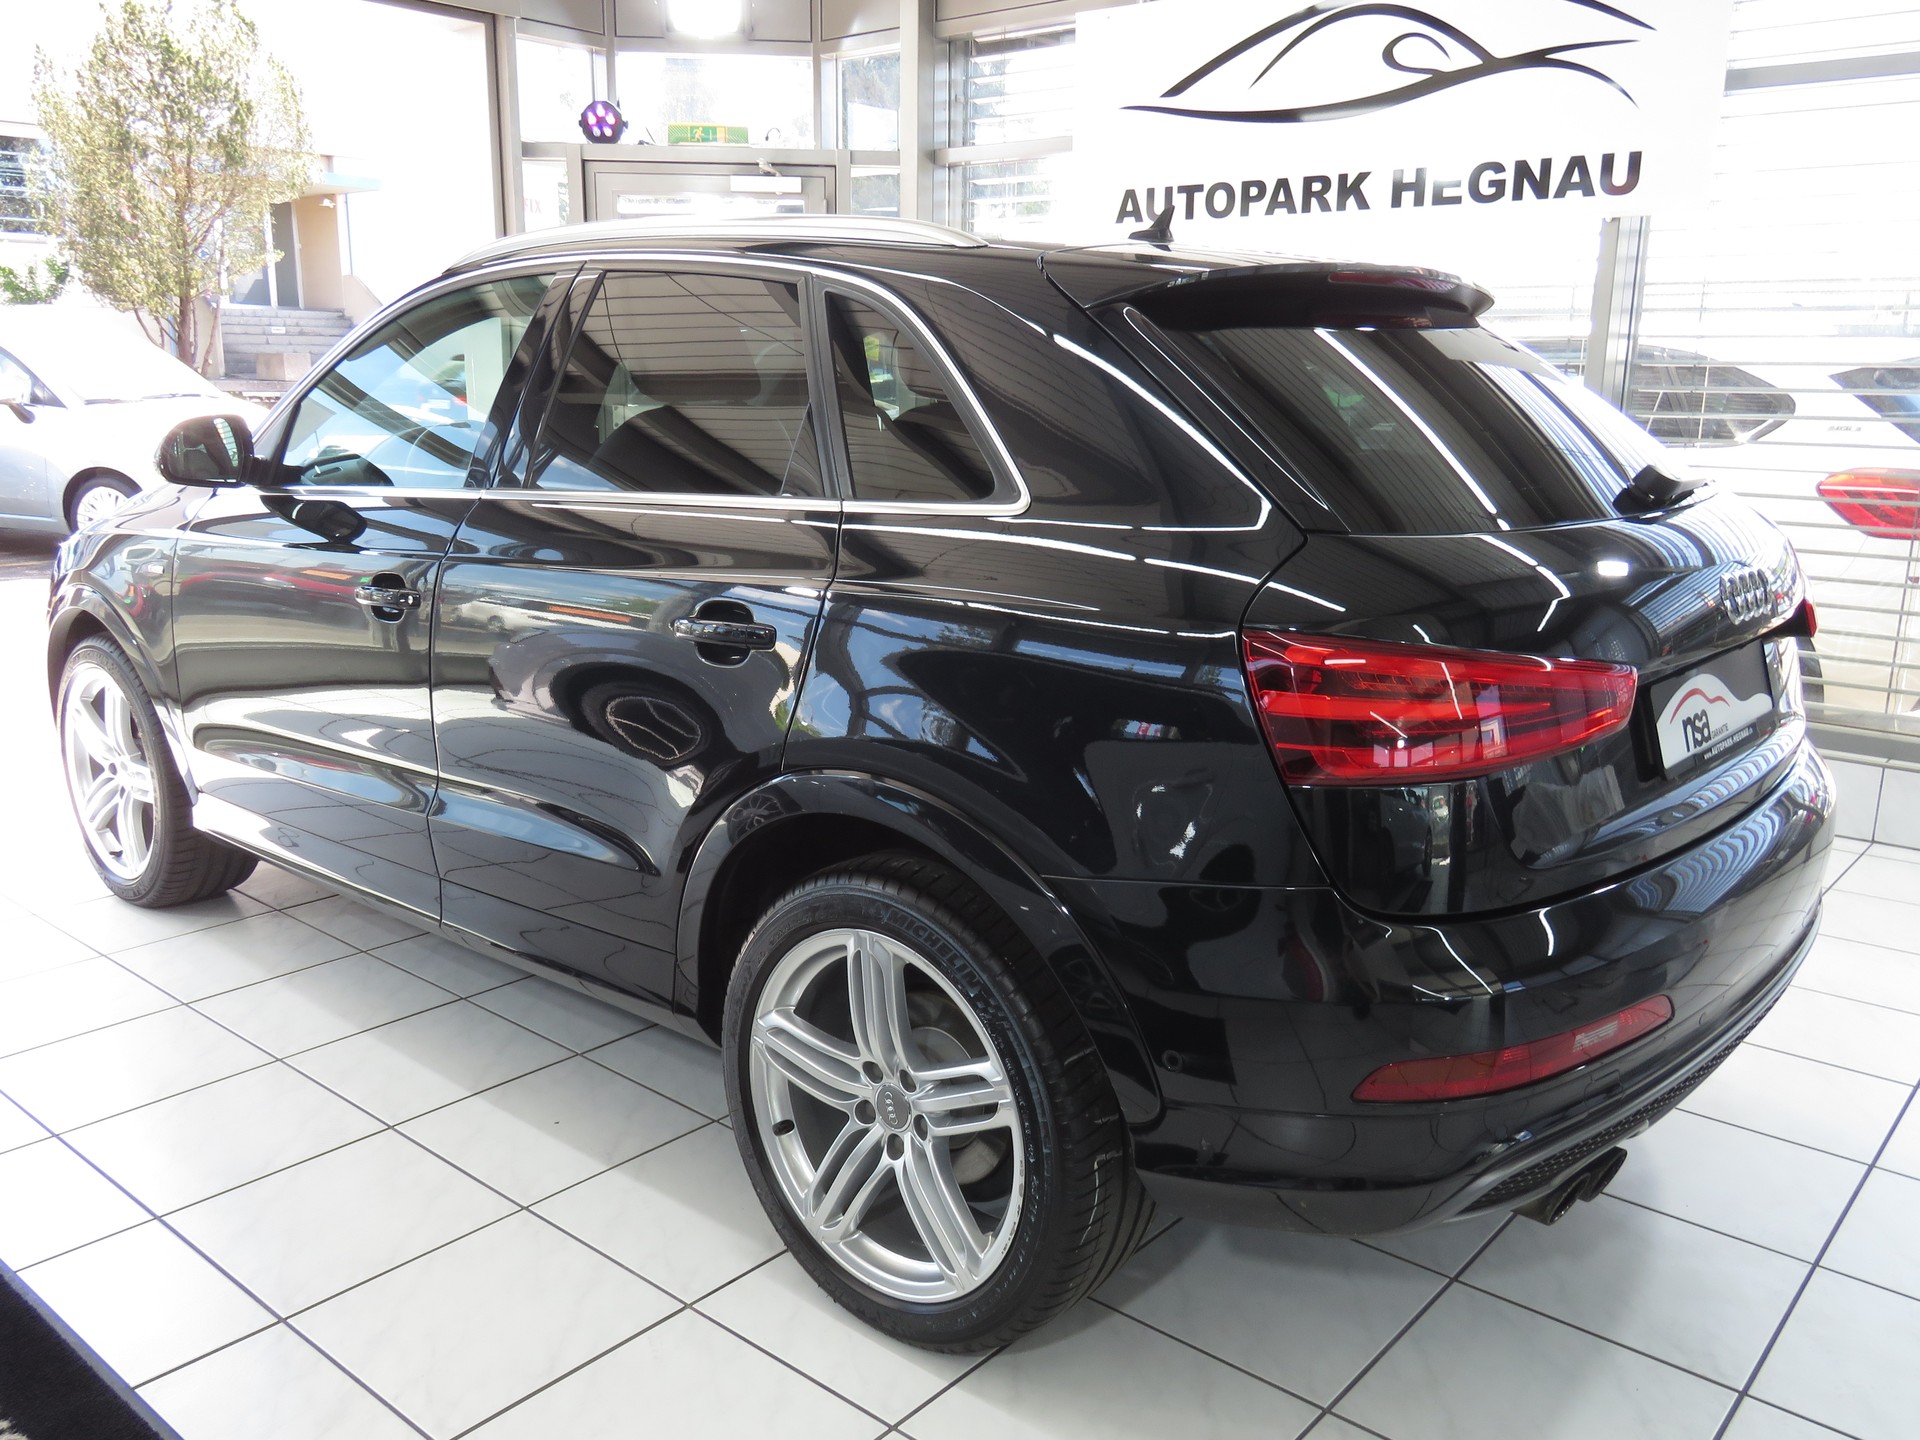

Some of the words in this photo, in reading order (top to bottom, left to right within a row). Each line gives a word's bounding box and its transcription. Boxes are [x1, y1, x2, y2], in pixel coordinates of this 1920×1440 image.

[1115, 171, 1372, 224] AUTOPARK
[1391, 150, 1643, 208] HEGNAU
[1681, 708, 1712, 753] nsa
[1711, 723, 1729, 739] GARANTIE
[880, 906, 983, 997] MICHELIN
